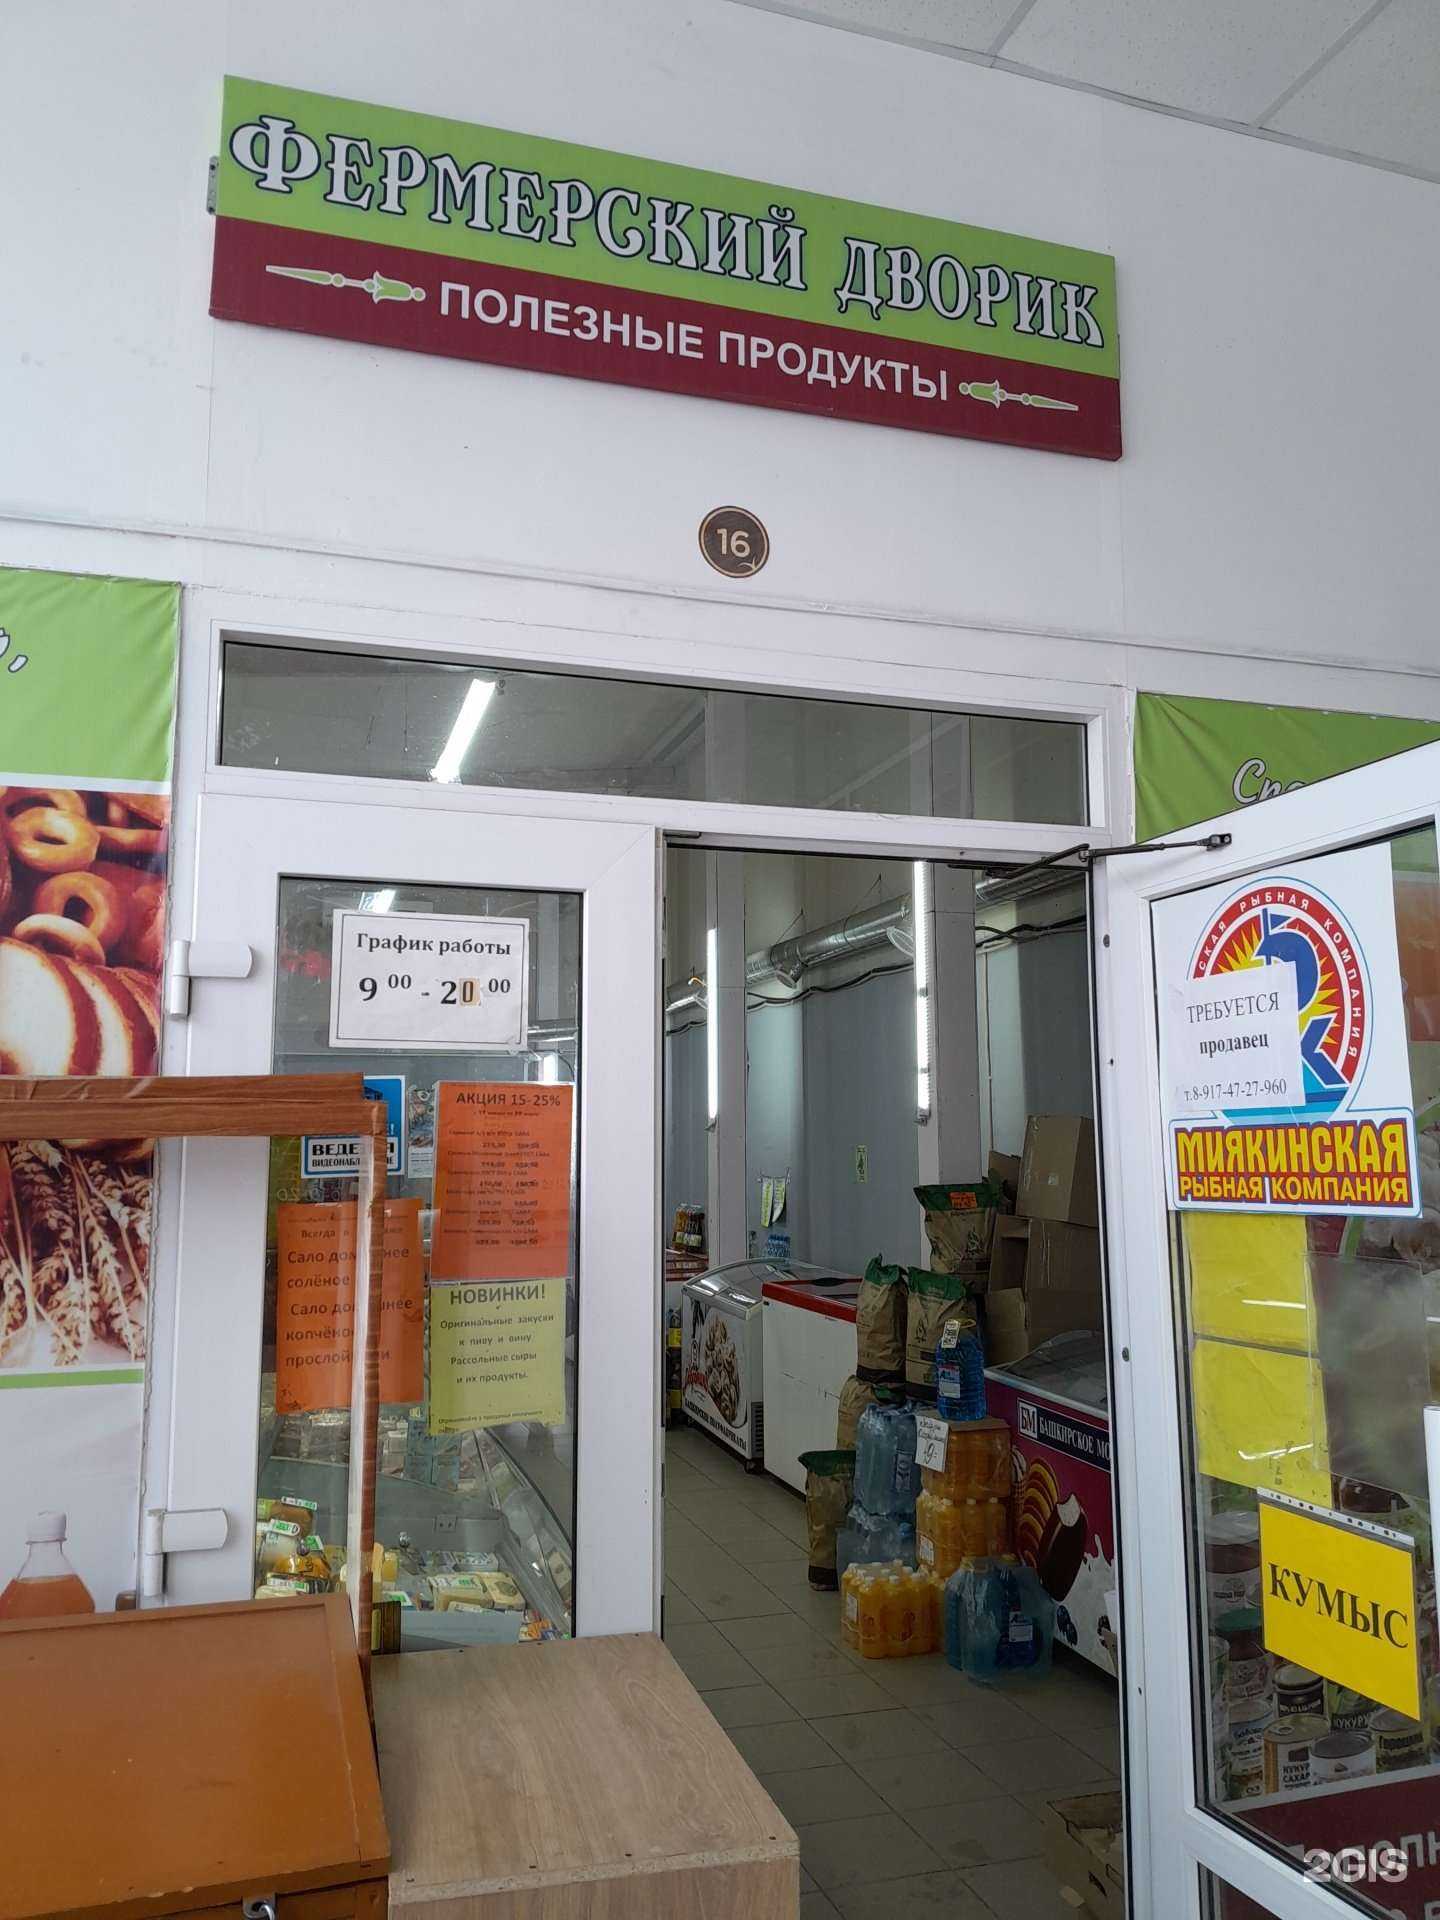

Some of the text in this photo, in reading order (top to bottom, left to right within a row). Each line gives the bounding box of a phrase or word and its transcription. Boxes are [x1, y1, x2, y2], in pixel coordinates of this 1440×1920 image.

[229, 115, 1105, 348] ФЕРМЕРСКИЙ ДВОРИК
[440, 281, 948, 401] ПОЛЕЗНЫЕ ПРОДУКТЫ
[716, 528, 750, 558] 16
[357, 933, 511, 956] График работы
[1239, 891, 1310, 913] РЫБНАЯ
[1324, 918, 1361, 1058] КОМПАНИЯ
[359, 977, 377, 1001] 9
[388, 974, 412, 989] 00
[488, 978, 511, 993] 00
[1187, 992, 1280, 1024] ТРЕБУЕТСЯ
[1200, 1031, 1269, 1057] продавец
[455, 1092, 561, 1107] АКЦИЯ 15-25%
[1184, 1078, 1287, 1103] т.8-917-47-27-960
[312, 1142, 394, 1157] ВЕДЕЯ
[1177, 1124, 1406, 1174] МИЯКИНСКАЯ
[1179, 1176, 1409, 1202] РЫБНАЯ КОМПАНИЯ
[288, 1247, 409, 1264] Сало донее
[288, 1273, 350, 1289] солёное
[450, 1283, 546, 1306] НОВИНКИ!
[291, 1298, 413, 1316] Сало донее
[286, 1324, 353, 1342] копчёно
[440, 1317, 512, 1330] Оригинальные
[470, 1337, 492, 1347] пиву
[508, 1335, 532, 1345] вину
[285, 1349, 390, 1368] прослойи
[450, 1352, 537, 1366] Рассольные сыры
[465, 1375, 477, 1384] их
[1039, 1416, 1095, 1454] БАШКИРСКОЕ
[1268, 1562, 1410, 1649] КУМЫС
